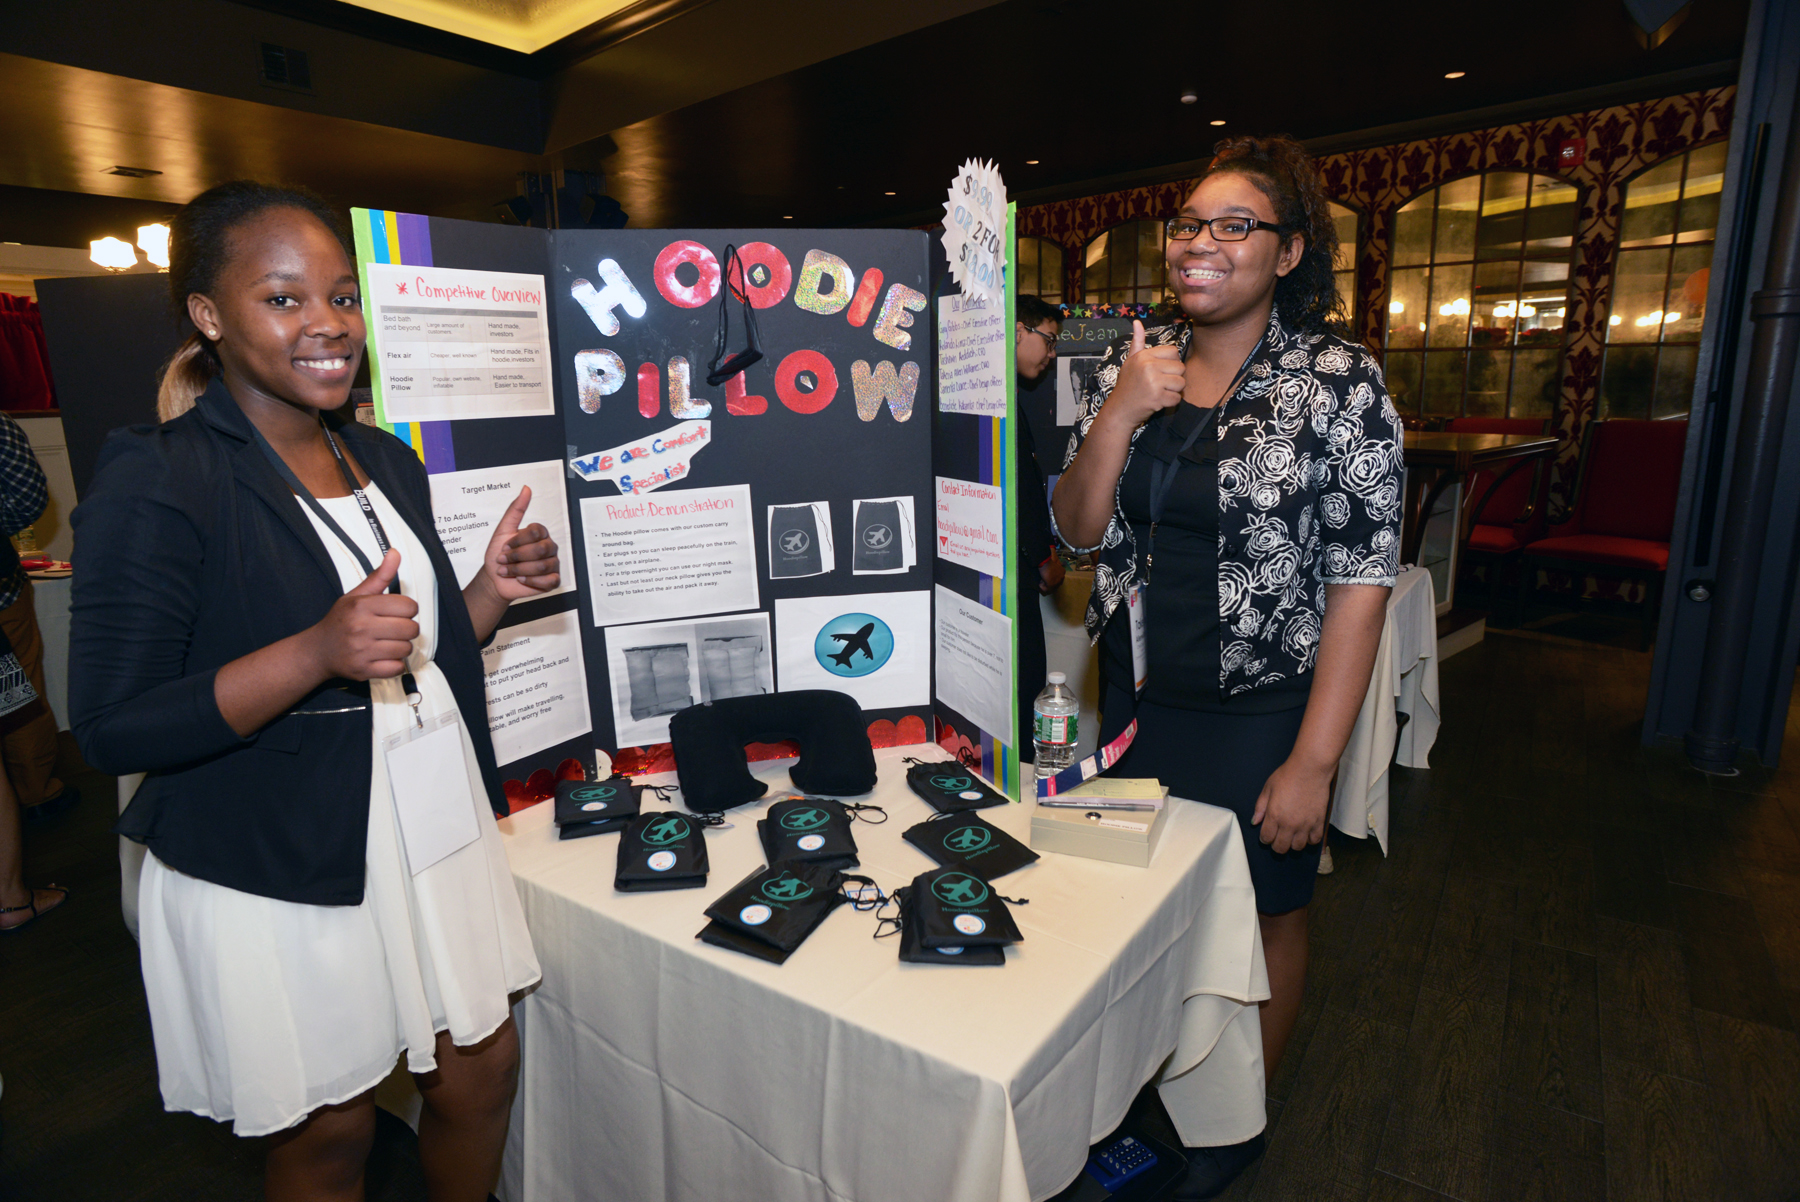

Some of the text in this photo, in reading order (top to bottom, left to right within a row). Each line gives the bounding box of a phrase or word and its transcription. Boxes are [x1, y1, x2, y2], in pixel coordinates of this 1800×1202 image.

[964, 174, 992, 211] $9.99
[954, 205, 972, 234] OR
[972, 221, 982, 240] 2
[416, 276, 541, 305] Competitive Overview
[571, 239, 927, 351] HOODIE
[1056, 323, 1118, 341] eJean
[574, 348, 920, 422] PILLOW
[575, 426, 707, 475] We are Comfort
[461, 486, 485, 494] Target
[942, 481, 996, 500] Contact Information
[354, 490, 371, 511] BUILD
[937, 499, 949, 512] Email
[449, 522, 489, 534] populations
[442, 537, 461, 545] ender
[966, 612, 983, 625] Customer
[496, 638, 530, 652] Statement
[488, 670, 499, 678] get
[501, 656, 544, 673] overwhelming
[499, 676, 509, 685] put
[511, 671, 524, 681] your
[526, 665, 541, 674] head
[543, 661, 556, 670] back
[534, 681, 548, 690] dirty
[489, 715, 504, 723] illow
[506, 709, 516, 717] will
[518, 704, 534, 713] make
[522, 711, 538, 720] worry
[965, 843, 1000, 860] Hoodiepillow
[750, 894, 791, 910] Hoodiepillow
